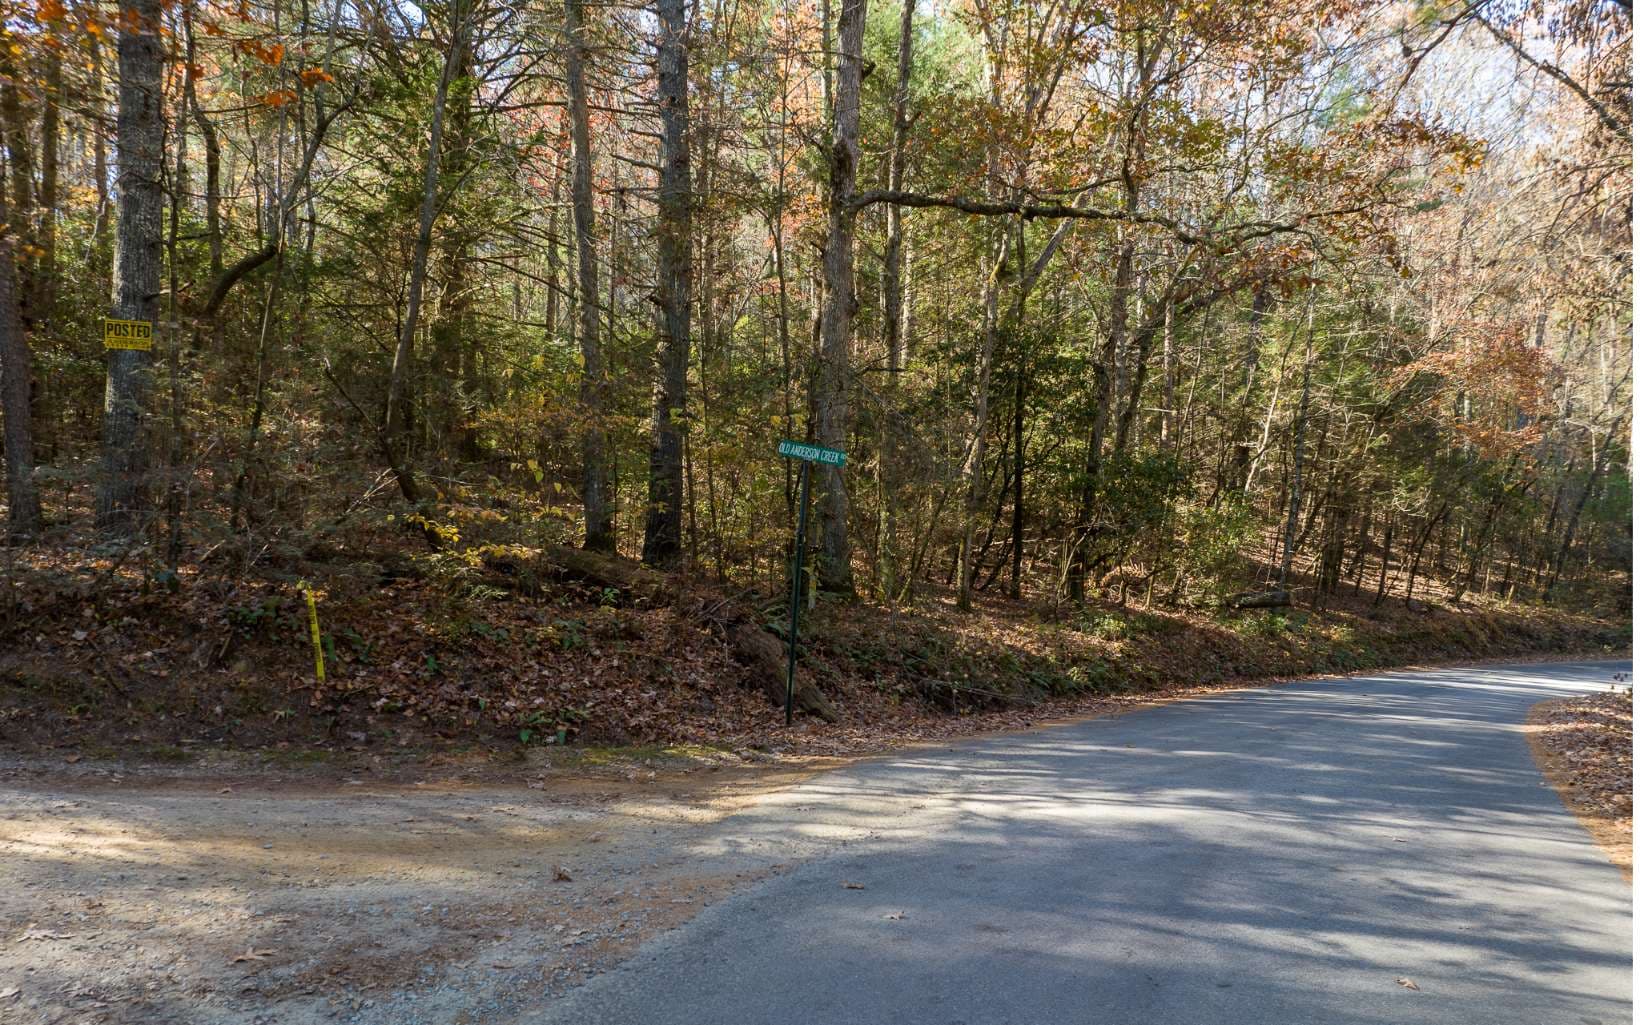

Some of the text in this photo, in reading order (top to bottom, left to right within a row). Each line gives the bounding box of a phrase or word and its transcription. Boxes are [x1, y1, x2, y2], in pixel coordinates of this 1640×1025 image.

[107, 323, 150, 338] POSTED
[779, 442, 790, 454] OLD
[790, 444, 820, 460] ANDERSON
[820, 450, 839, 463] CREEK
